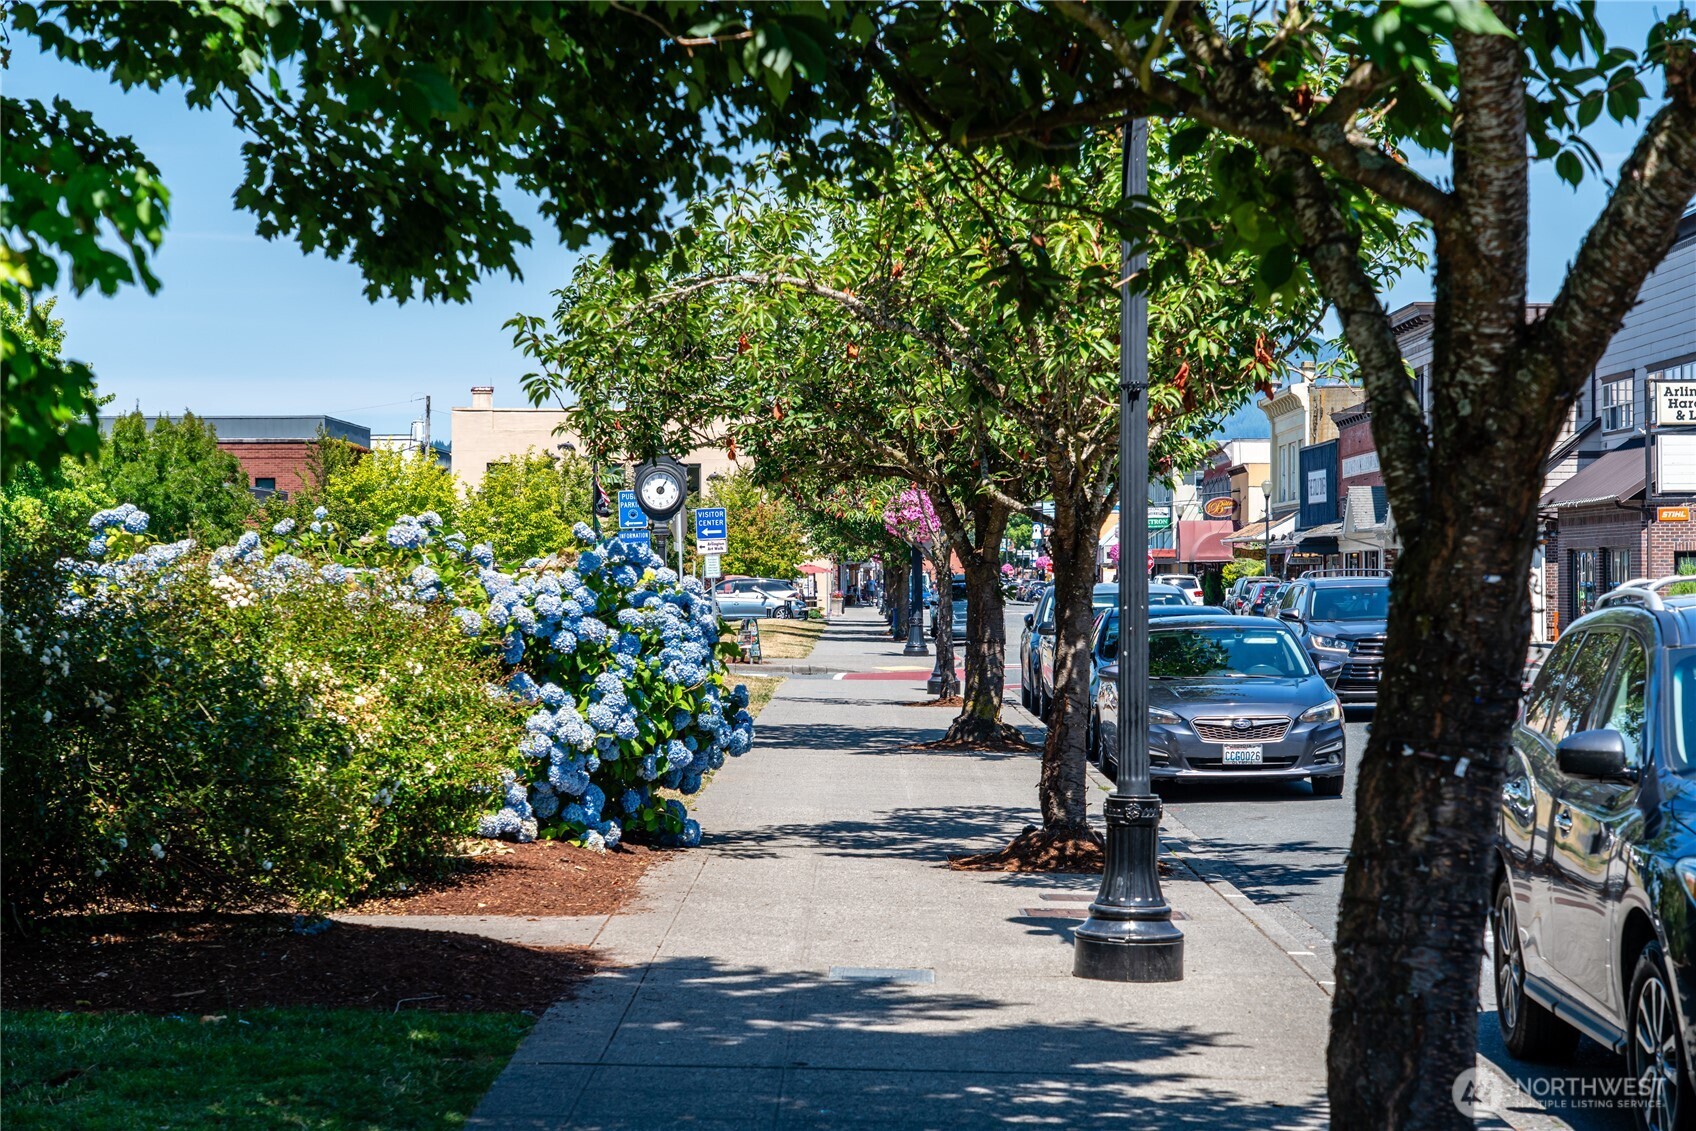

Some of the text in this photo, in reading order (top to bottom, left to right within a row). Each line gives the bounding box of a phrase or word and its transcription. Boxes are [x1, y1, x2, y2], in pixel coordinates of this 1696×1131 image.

[1668, 399, 1696, 408] Har
[1676, 410, 1685, 420] &
[698, 519, 724, 527] CENTER
[1226, 751, 1260, 760] CCG0026
